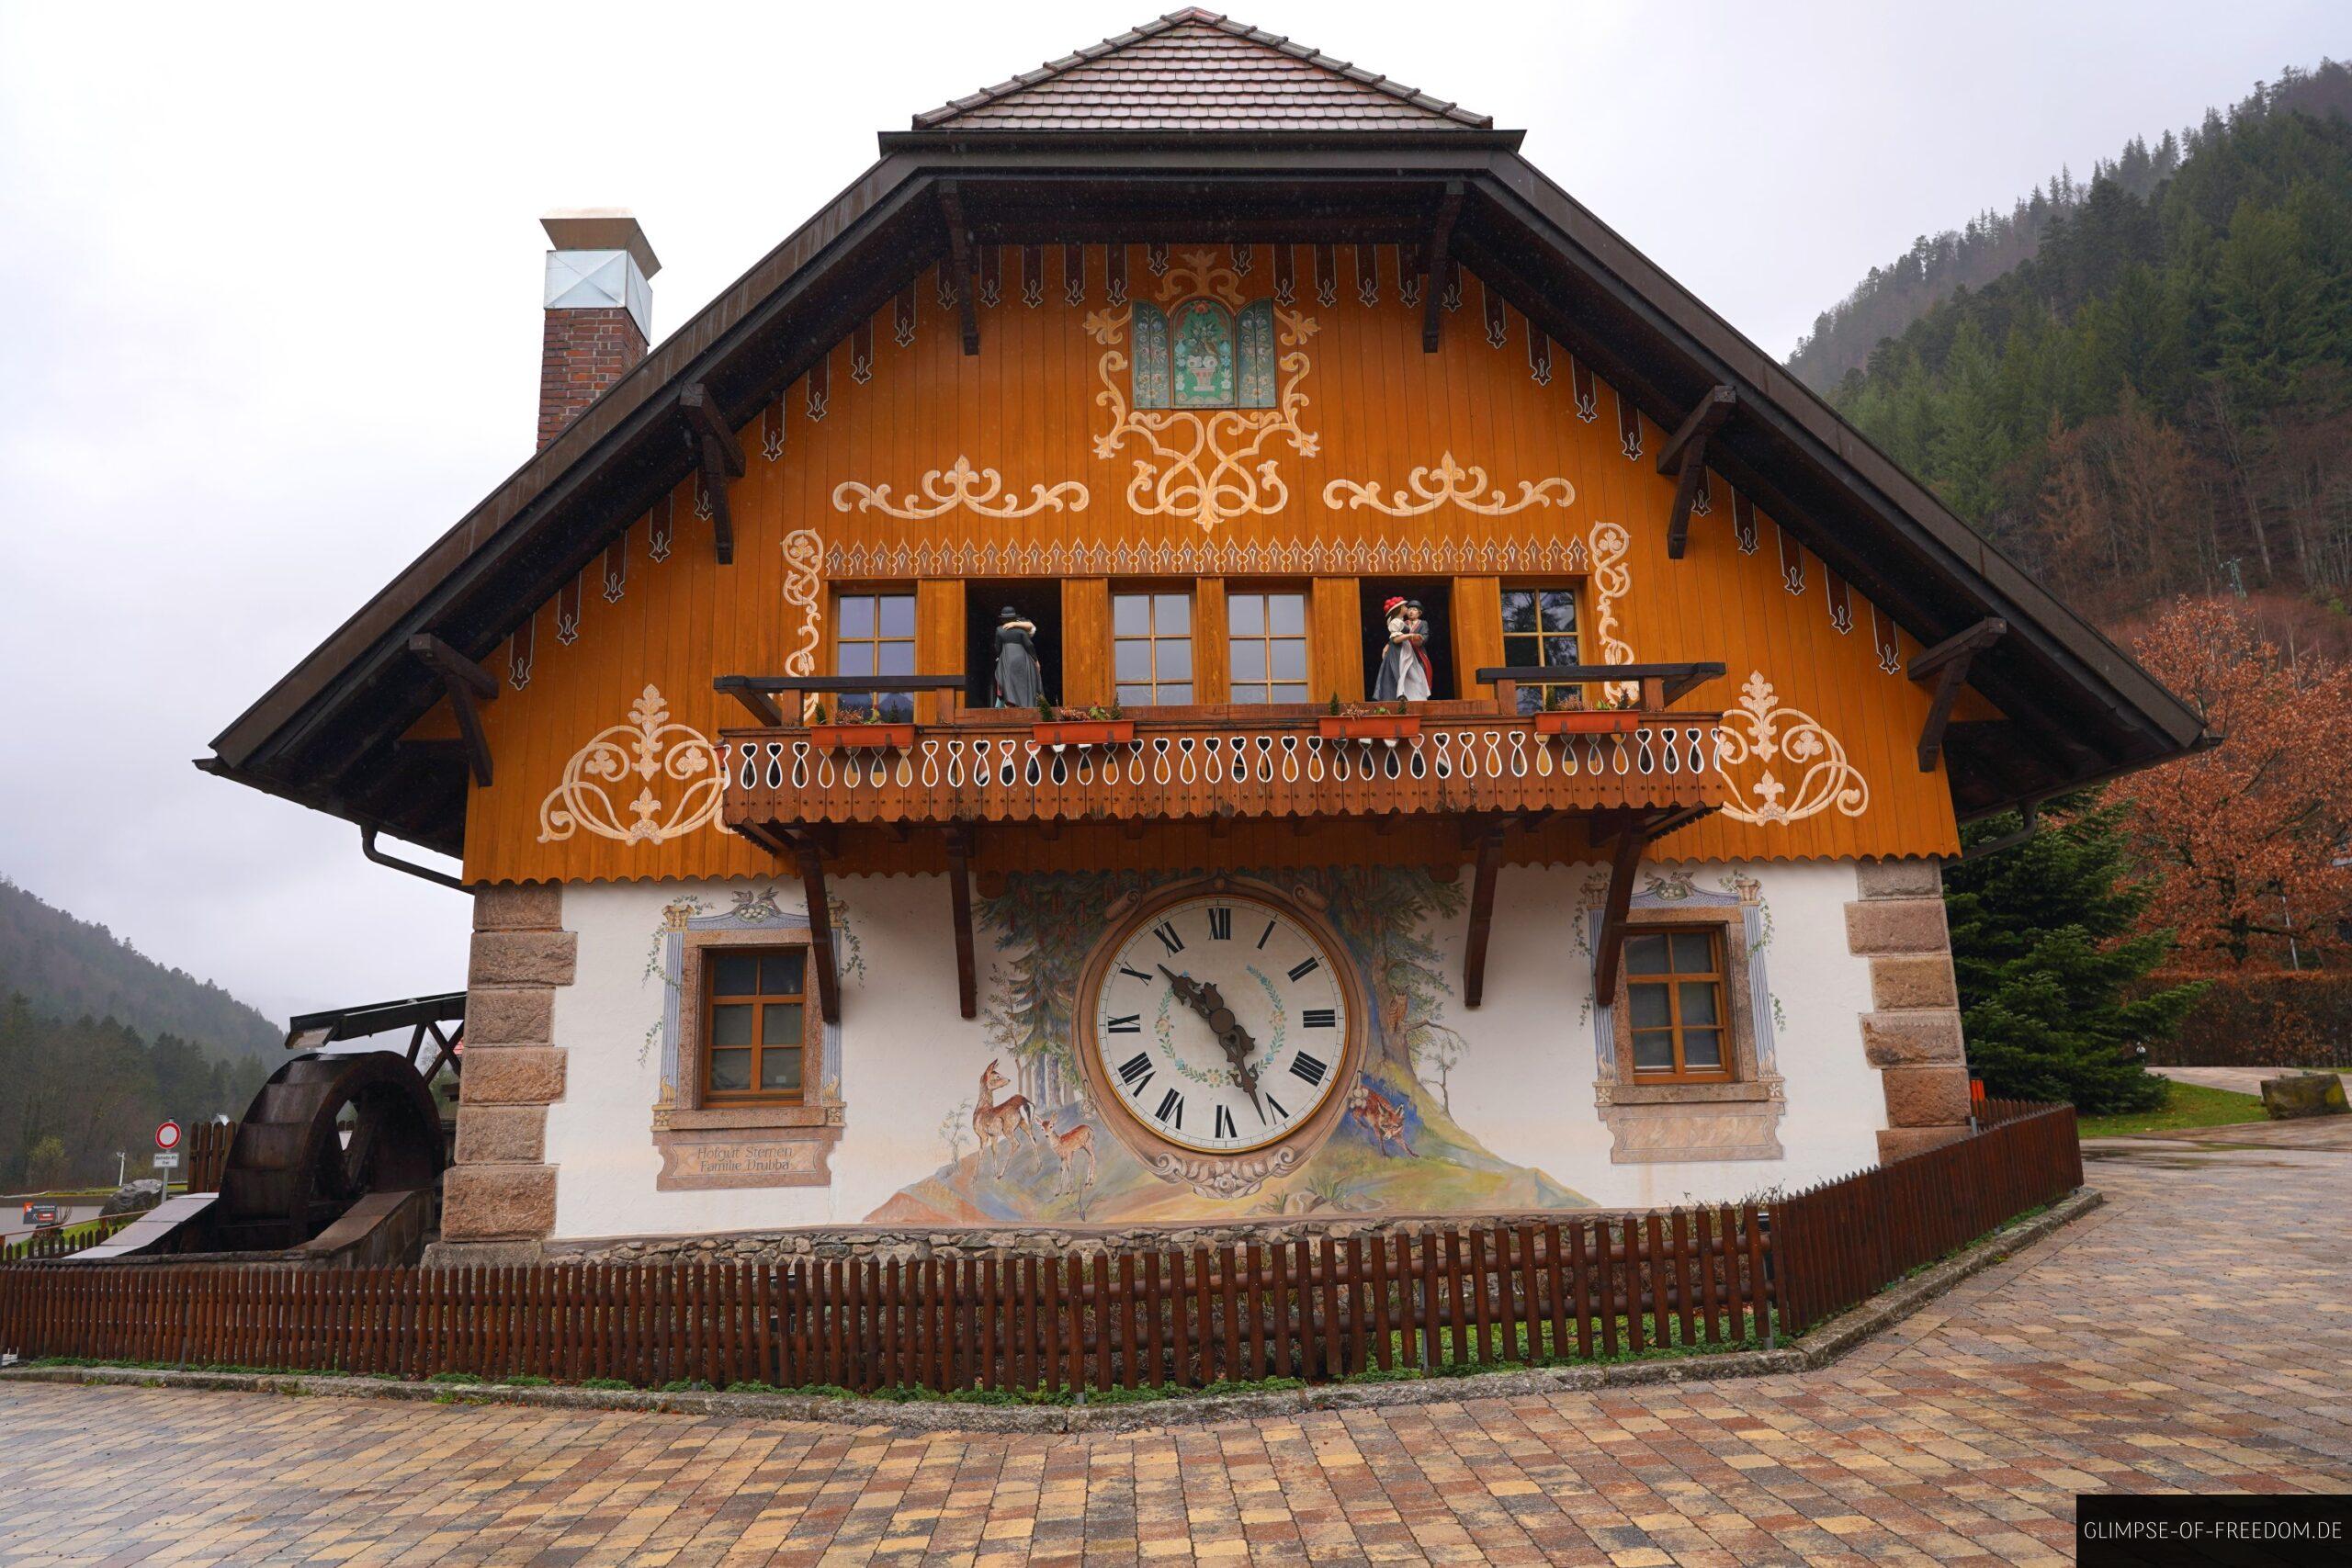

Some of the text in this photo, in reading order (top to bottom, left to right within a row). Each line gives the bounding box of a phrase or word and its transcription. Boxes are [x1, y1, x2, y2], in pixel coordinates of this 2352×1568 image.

[1153, 920, 1185, 957] XI
[1207, 908, 1231, 941] XII
[1257, 919, 1276, 950] I
[1119, 962, 1153, 986] X
[1287, 956, 1319, 982] II
[1107, 1014, 1140, 1033] IX
[1302, 1009, 1336, 1028] III
[1117, 1051, 1157, 1098] VIII
[1289, 1050, 1328, 1087] IIII
[1154, 1088, 1184, 1130] VII
[1215, 1104, 1238, 1138] VI
[1265, 1092, 1289, 1124] V
[697, 1145, 740, 1162] Hofgut
[700, 1158, 790, 1172] Familie Drubba
